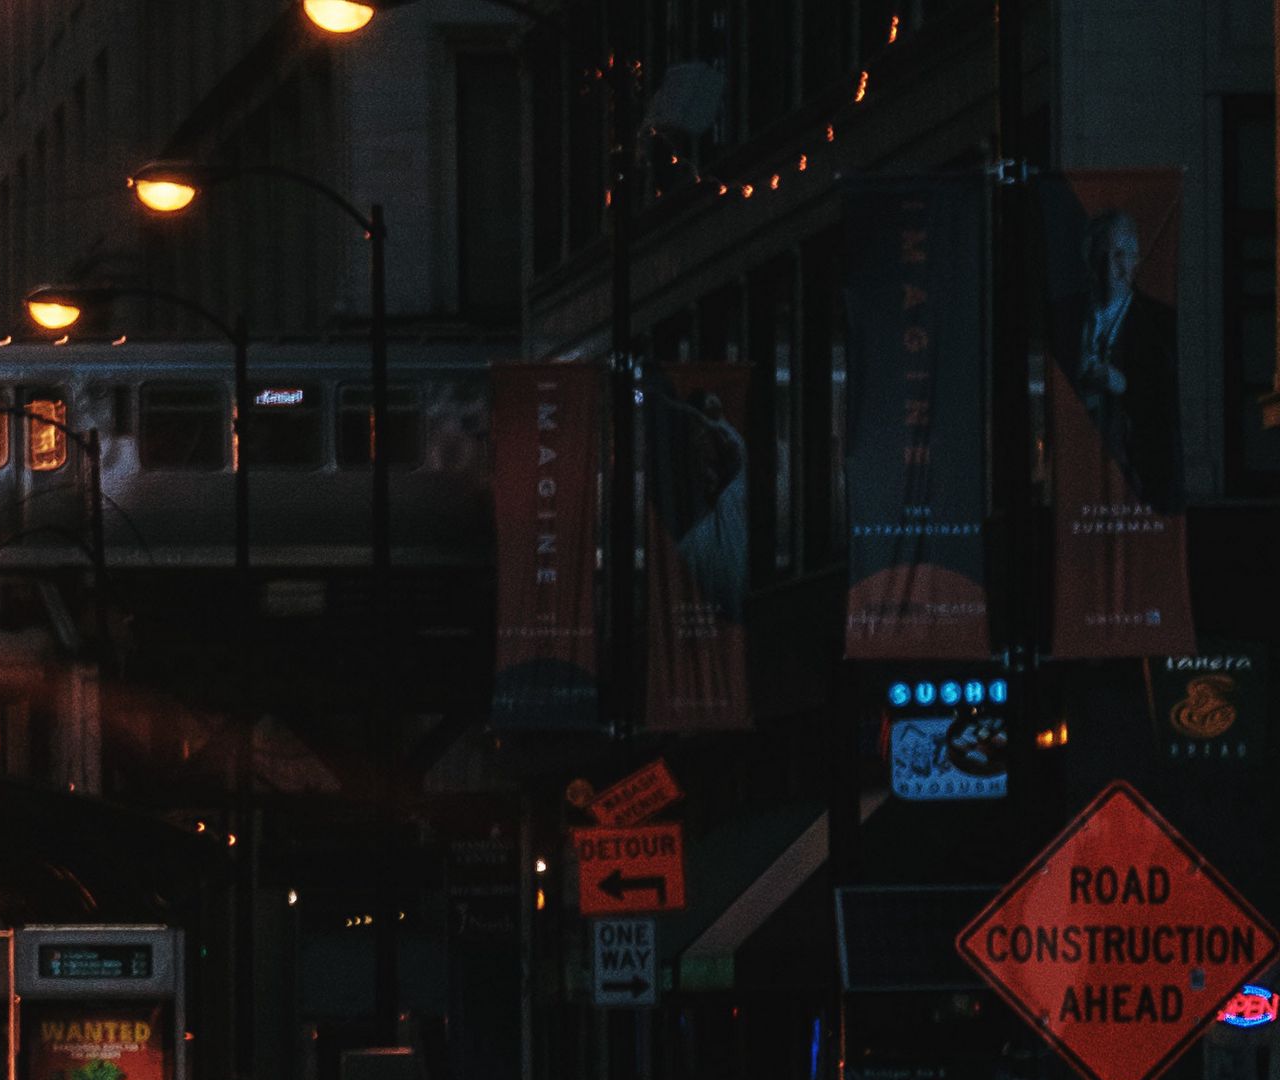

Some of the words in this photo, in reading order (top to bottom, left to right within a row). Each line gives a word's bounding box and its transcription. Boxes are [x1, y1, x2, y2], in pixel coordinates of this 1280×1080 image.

[900, 200, 929, 465] IMAGINE
[536, 380, 558, 588] IMAGINE
[891, 681, 1005, 706] SUSHI
[899, 782, 1006, 794] RYOSUSH
[581, 835, 676, 860] DETOUR
[1070, 865, 1171, 904] ROAD
[600, 924, 650, 947] ONE
[985, 925, 1255, 964] CONSTRUCTION
[601, 949, 650, 970] WAY
[1059, 985, 1184, 1023] AHEAD
[41, 1021, 151, 1043] WANTED
